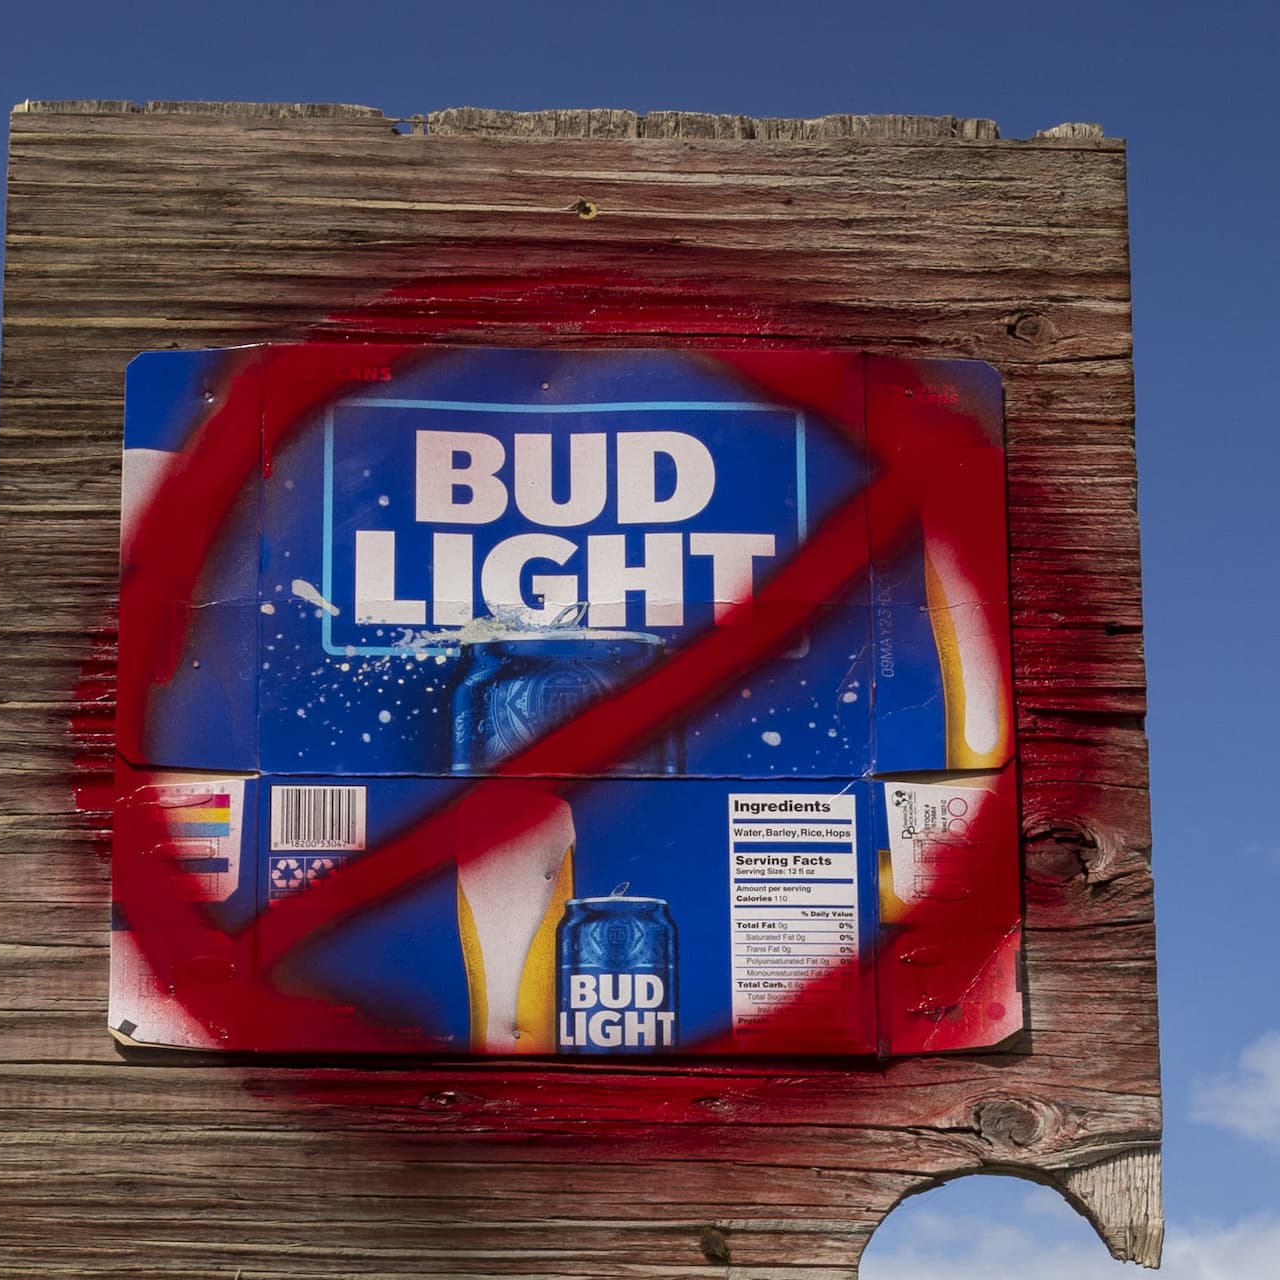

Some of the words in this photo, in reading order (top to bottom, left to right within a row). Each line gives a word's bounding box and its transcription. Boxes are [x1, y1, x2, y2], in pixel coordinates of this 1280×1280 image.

[416, 429, 716, 527] BUD
[355, 530, 776, 628] LIGHT
[734, 800, 831, 814] Ingredients
[734, 829, 765, 838] Water,
[766, 828, 799, 838] Barley,
[800, 828, 824, 838] Rice,
[825, 828, 851, 838] Hops
[736, 855, 788, 867] Serving
[793, 856, 832, 866] Facts
[736, 868, 765, 876] Serving
[768, 886, 781, 894] per
[783, 885, 811, 894] serving
[796, 934, 806, 942] 0g
[570, 974, 664, 1009] BUD
[559, 1010, 676, 1047] LIGHT
